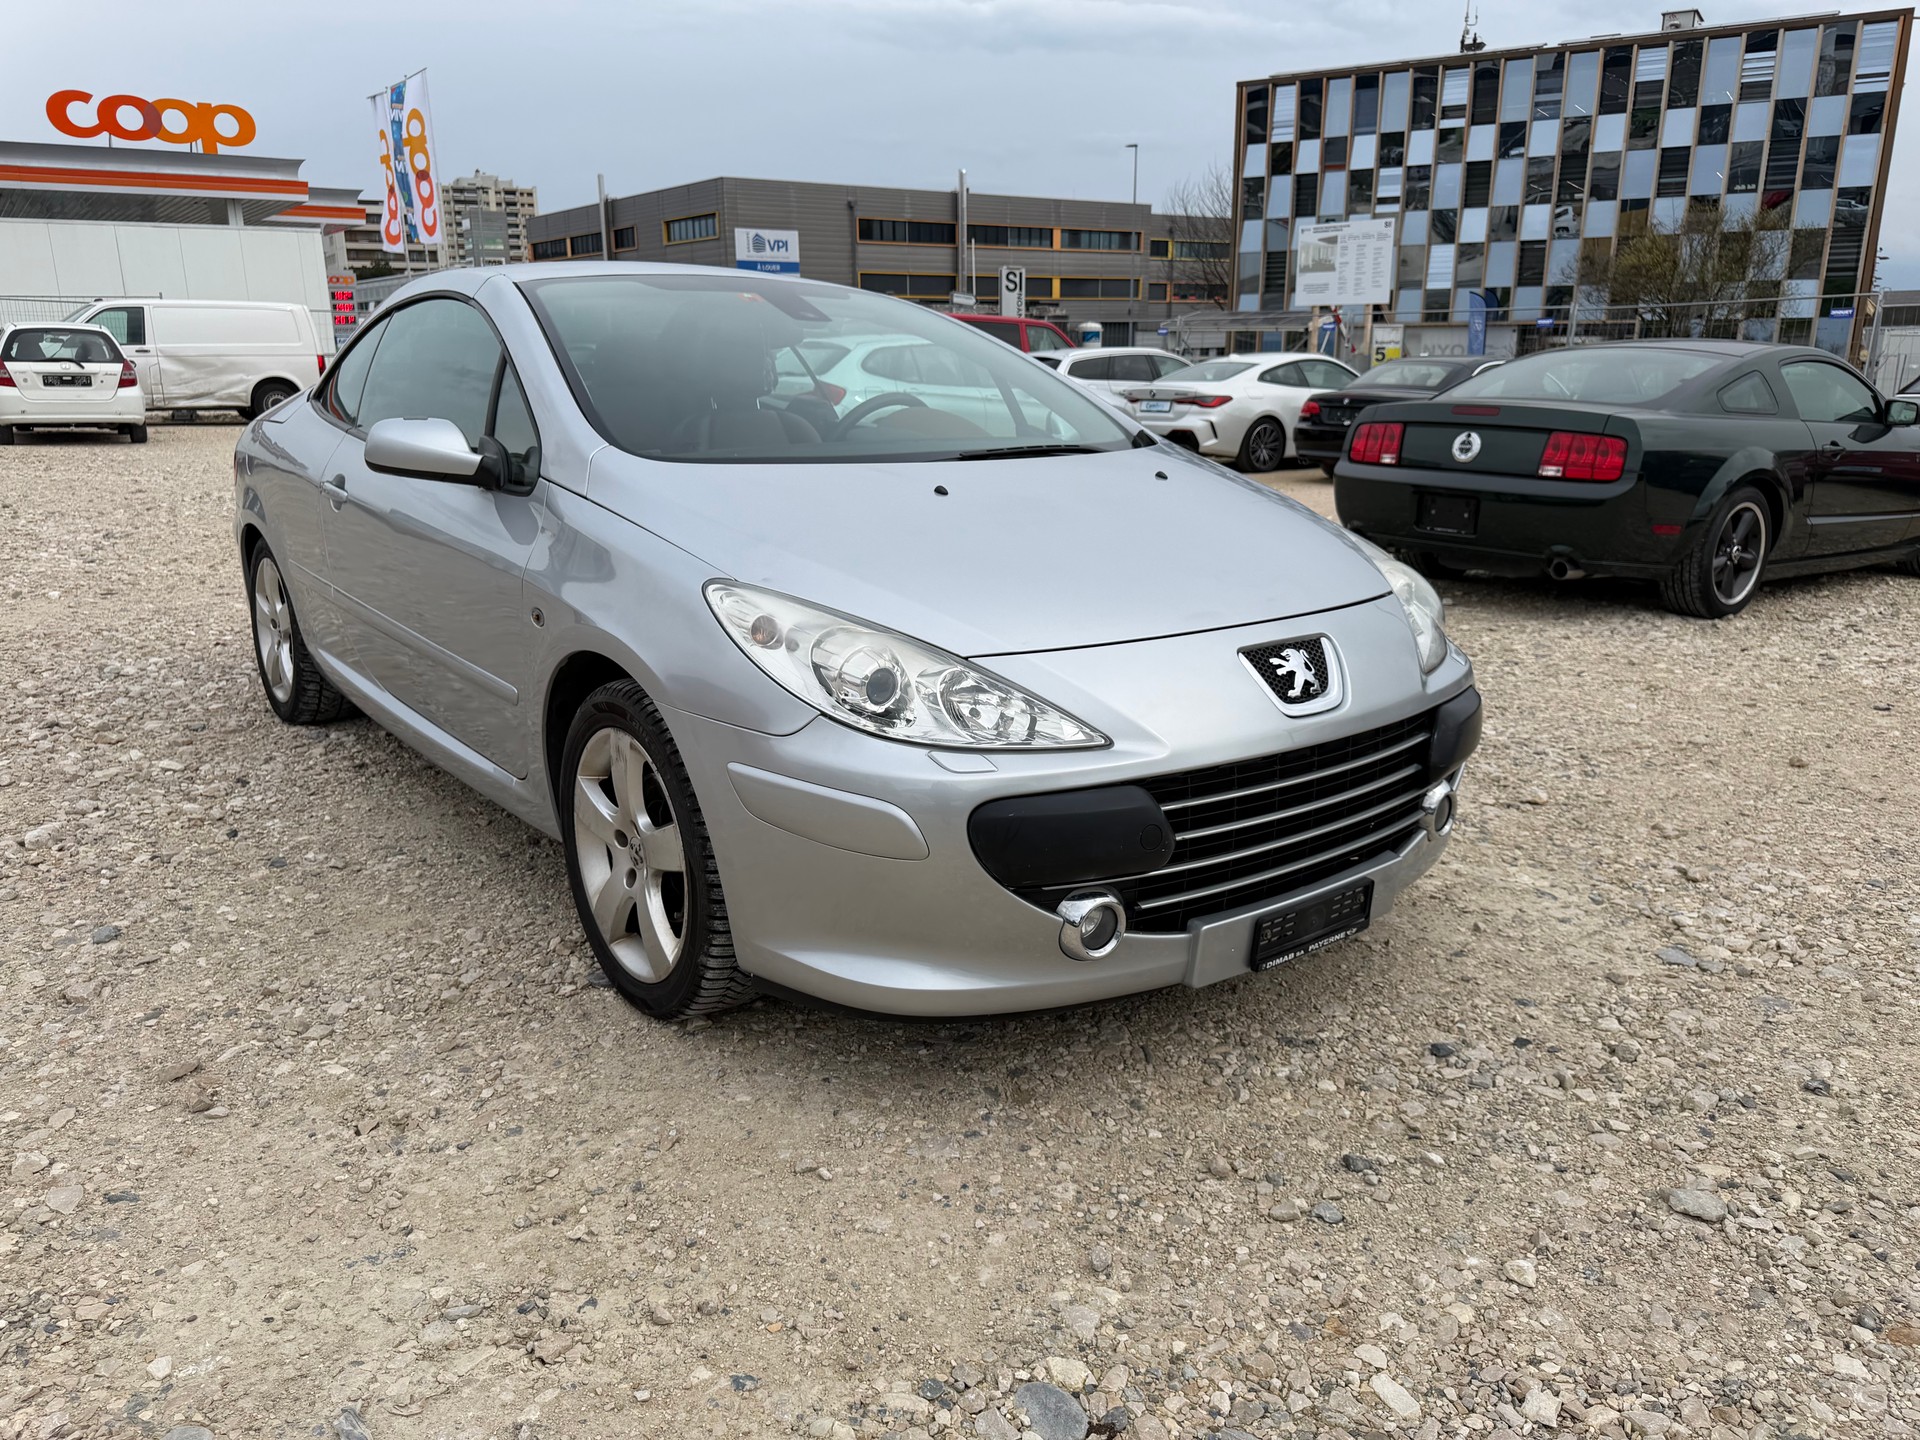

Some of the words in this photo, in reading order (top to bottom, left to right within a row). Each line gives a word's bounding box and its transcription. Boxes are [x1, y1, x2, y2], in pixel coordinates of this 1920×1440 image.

[46, 89, 256, 155] coop
[402, 108, 437, 237] coop
[767, 239, 789, 253] VPI
[328, 276, 355, 286] oop
[1005, 271, 1023, 293] SI
[1375, 347, 1386, 362] 5
[1266, 952, 1295, 970] DIMAB
[1308, 931, 1346, 952] PAYERNE
